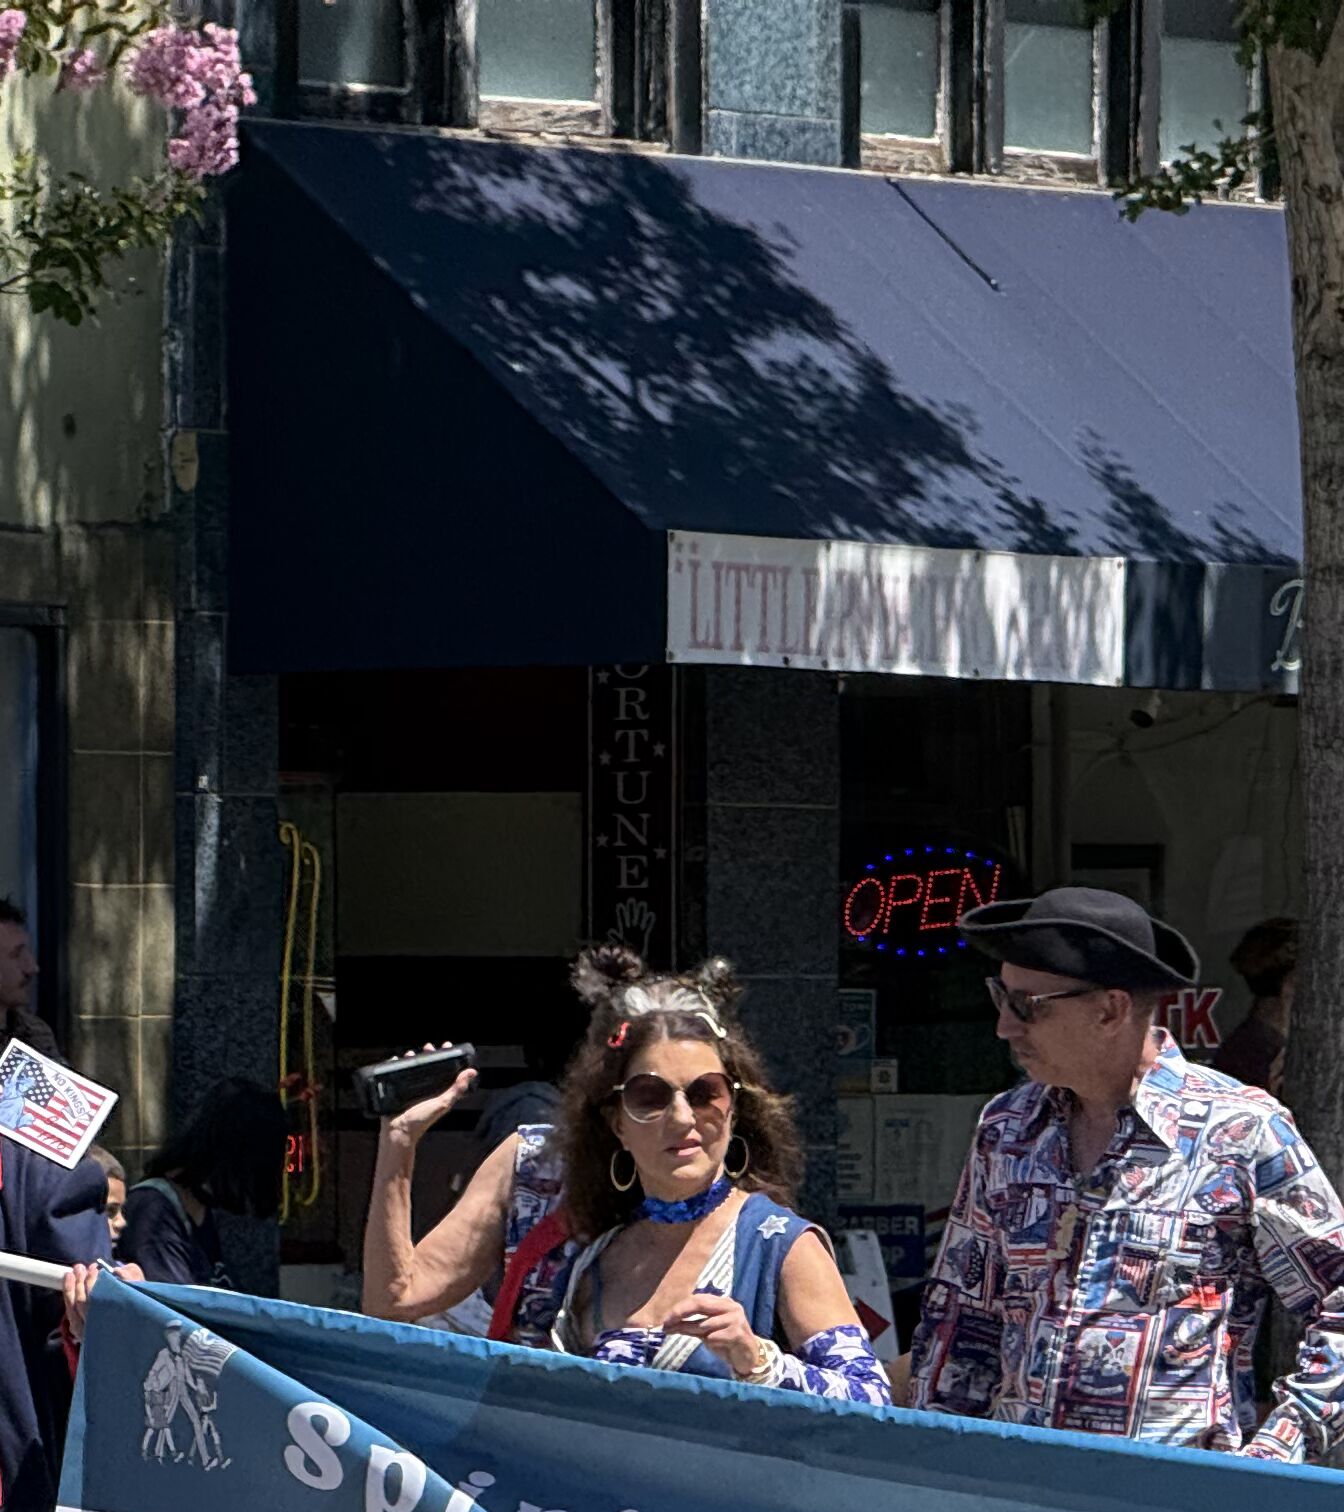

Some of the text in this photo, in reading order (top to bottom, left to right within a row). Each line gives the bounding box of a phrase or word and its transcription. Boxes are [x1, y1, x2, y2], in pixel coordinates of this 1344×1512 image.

[844, 863, 1001, 935] OPEN
[51, 1073, 87, 1116] NO KINGS
